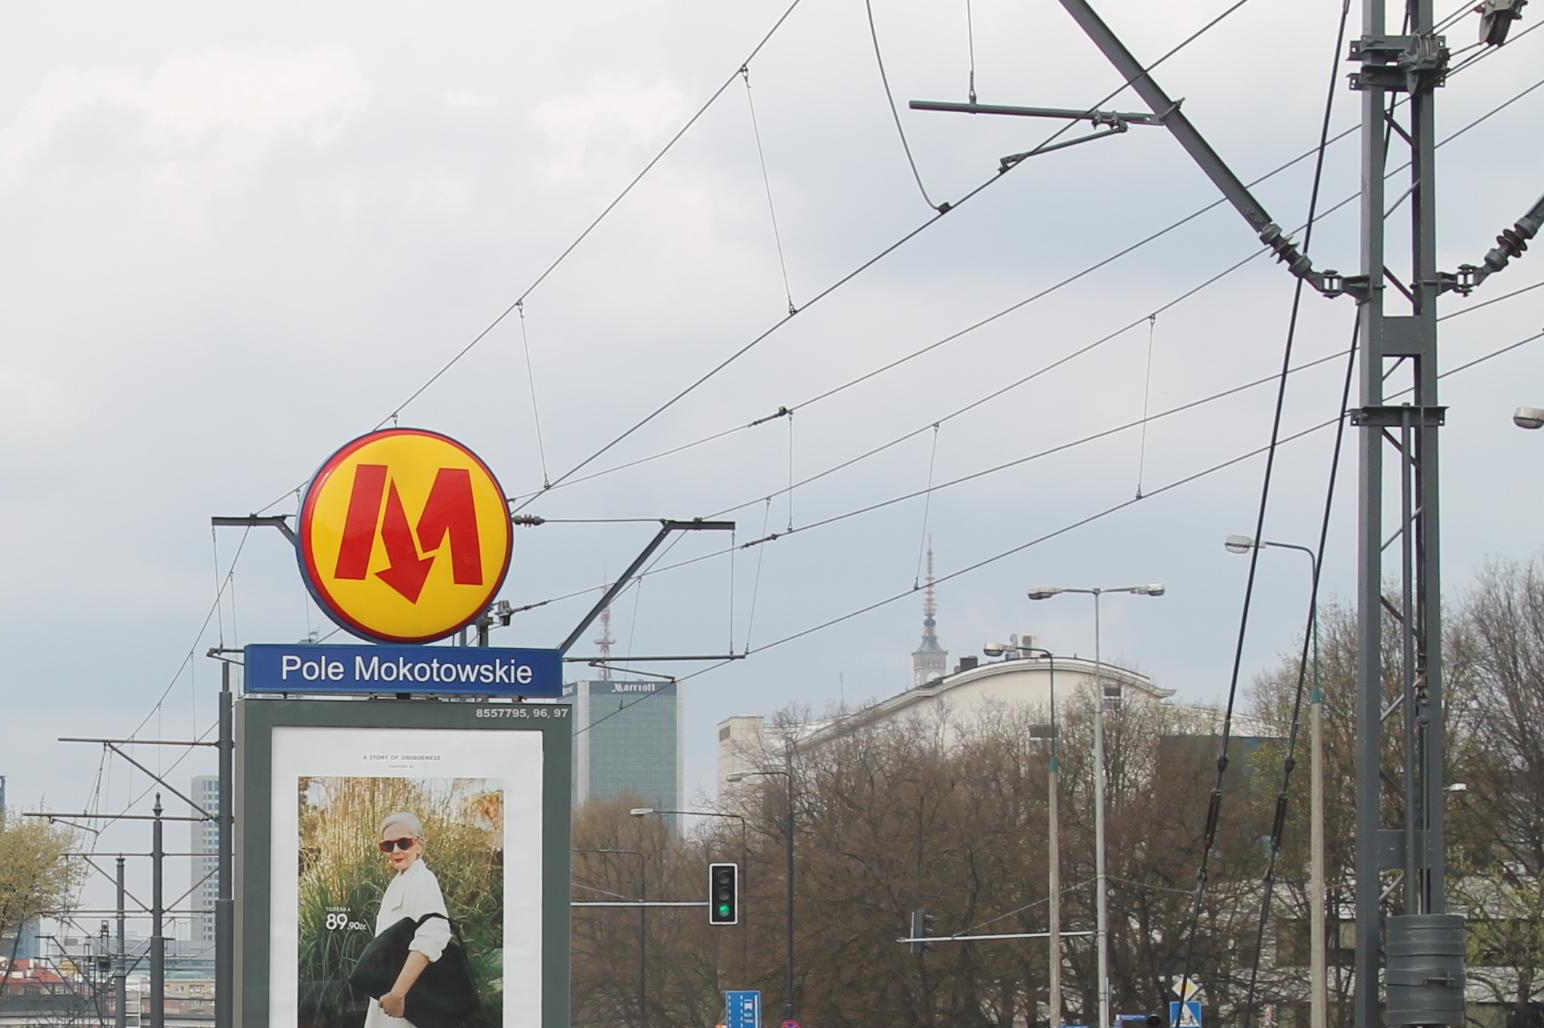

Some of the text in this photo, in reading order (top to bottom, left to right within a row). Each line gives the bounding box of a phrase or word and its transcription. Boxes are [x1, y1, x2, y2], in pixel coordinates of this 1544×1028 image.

[281, 655, 533, 684] Pole Mokotowskie
[475, 708, 569, 720] 8557795, 96, 97
